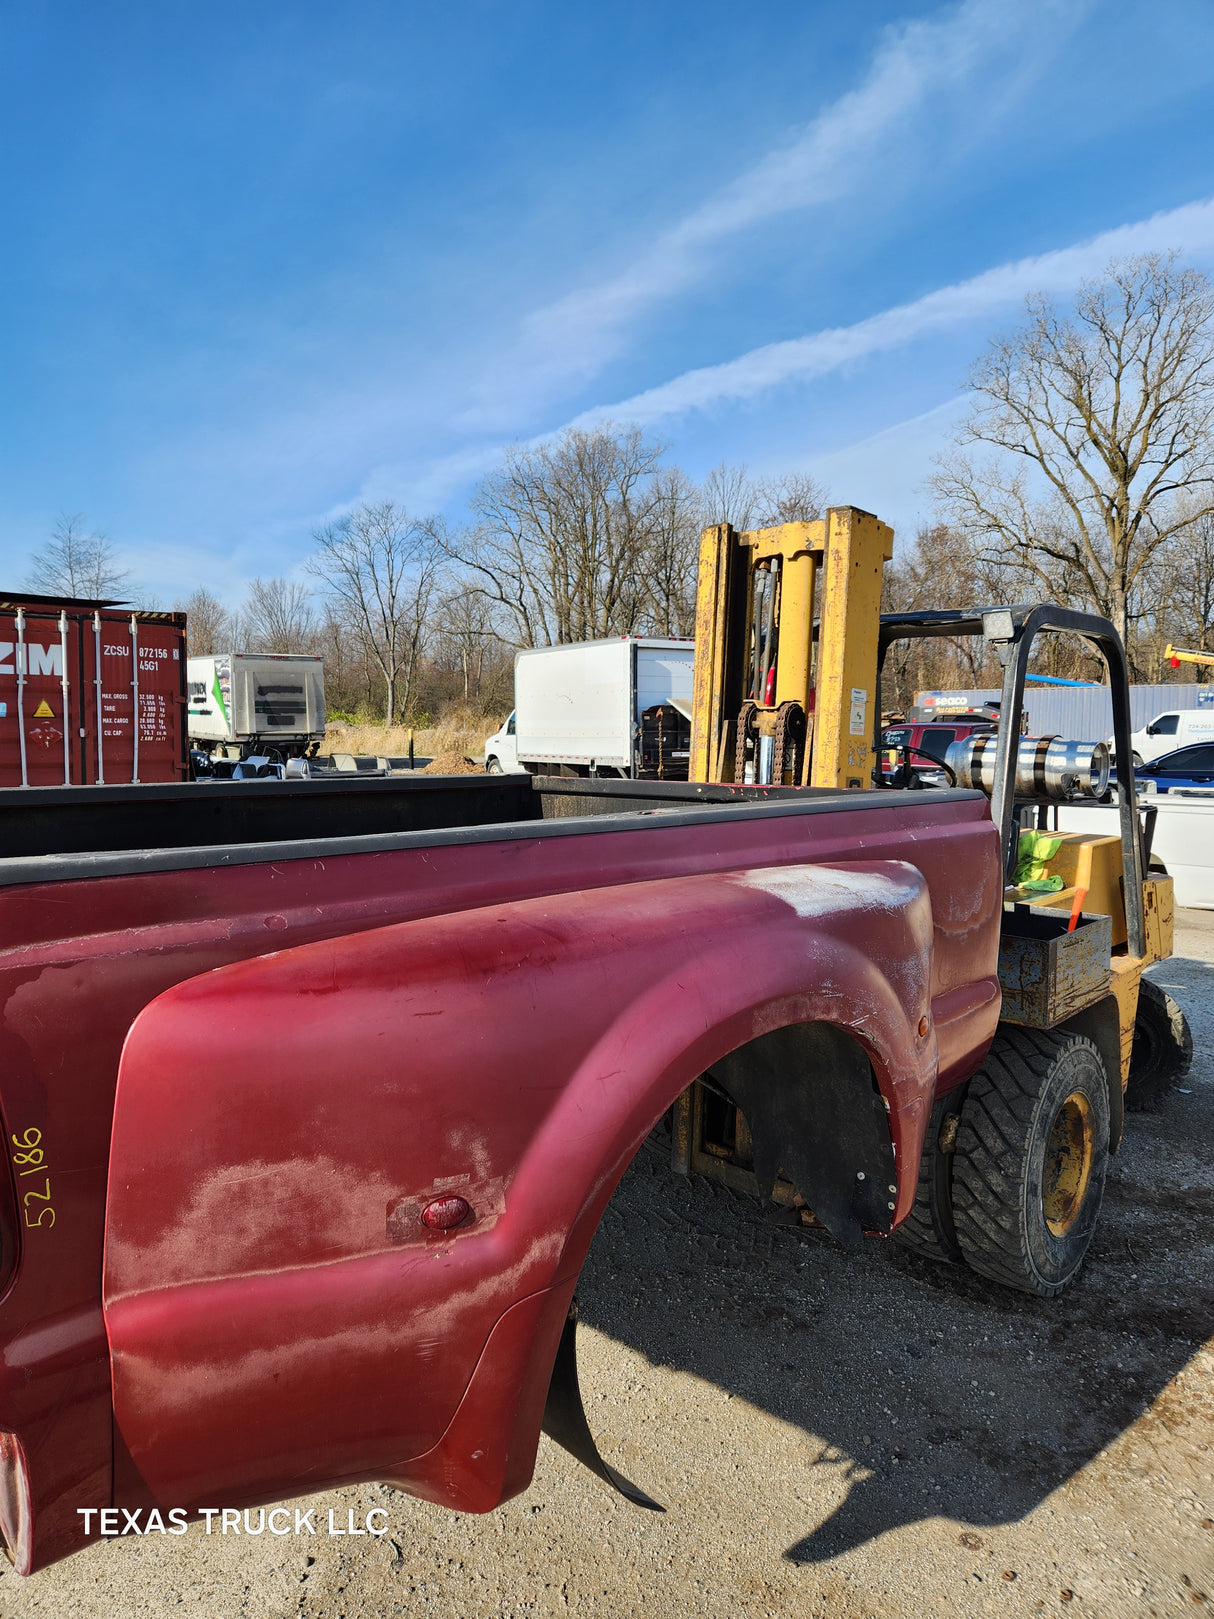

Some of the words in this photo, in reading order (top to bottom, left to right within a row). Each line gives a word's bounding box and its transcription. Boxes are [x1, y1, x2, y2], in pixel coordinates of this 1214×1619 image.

[0, 641, 63, 676] ZIM
[103, 645, 129, 656] ZCSU
[139, 647, 168, 659] 872156
[139, 660, 159, 671] 45G1
